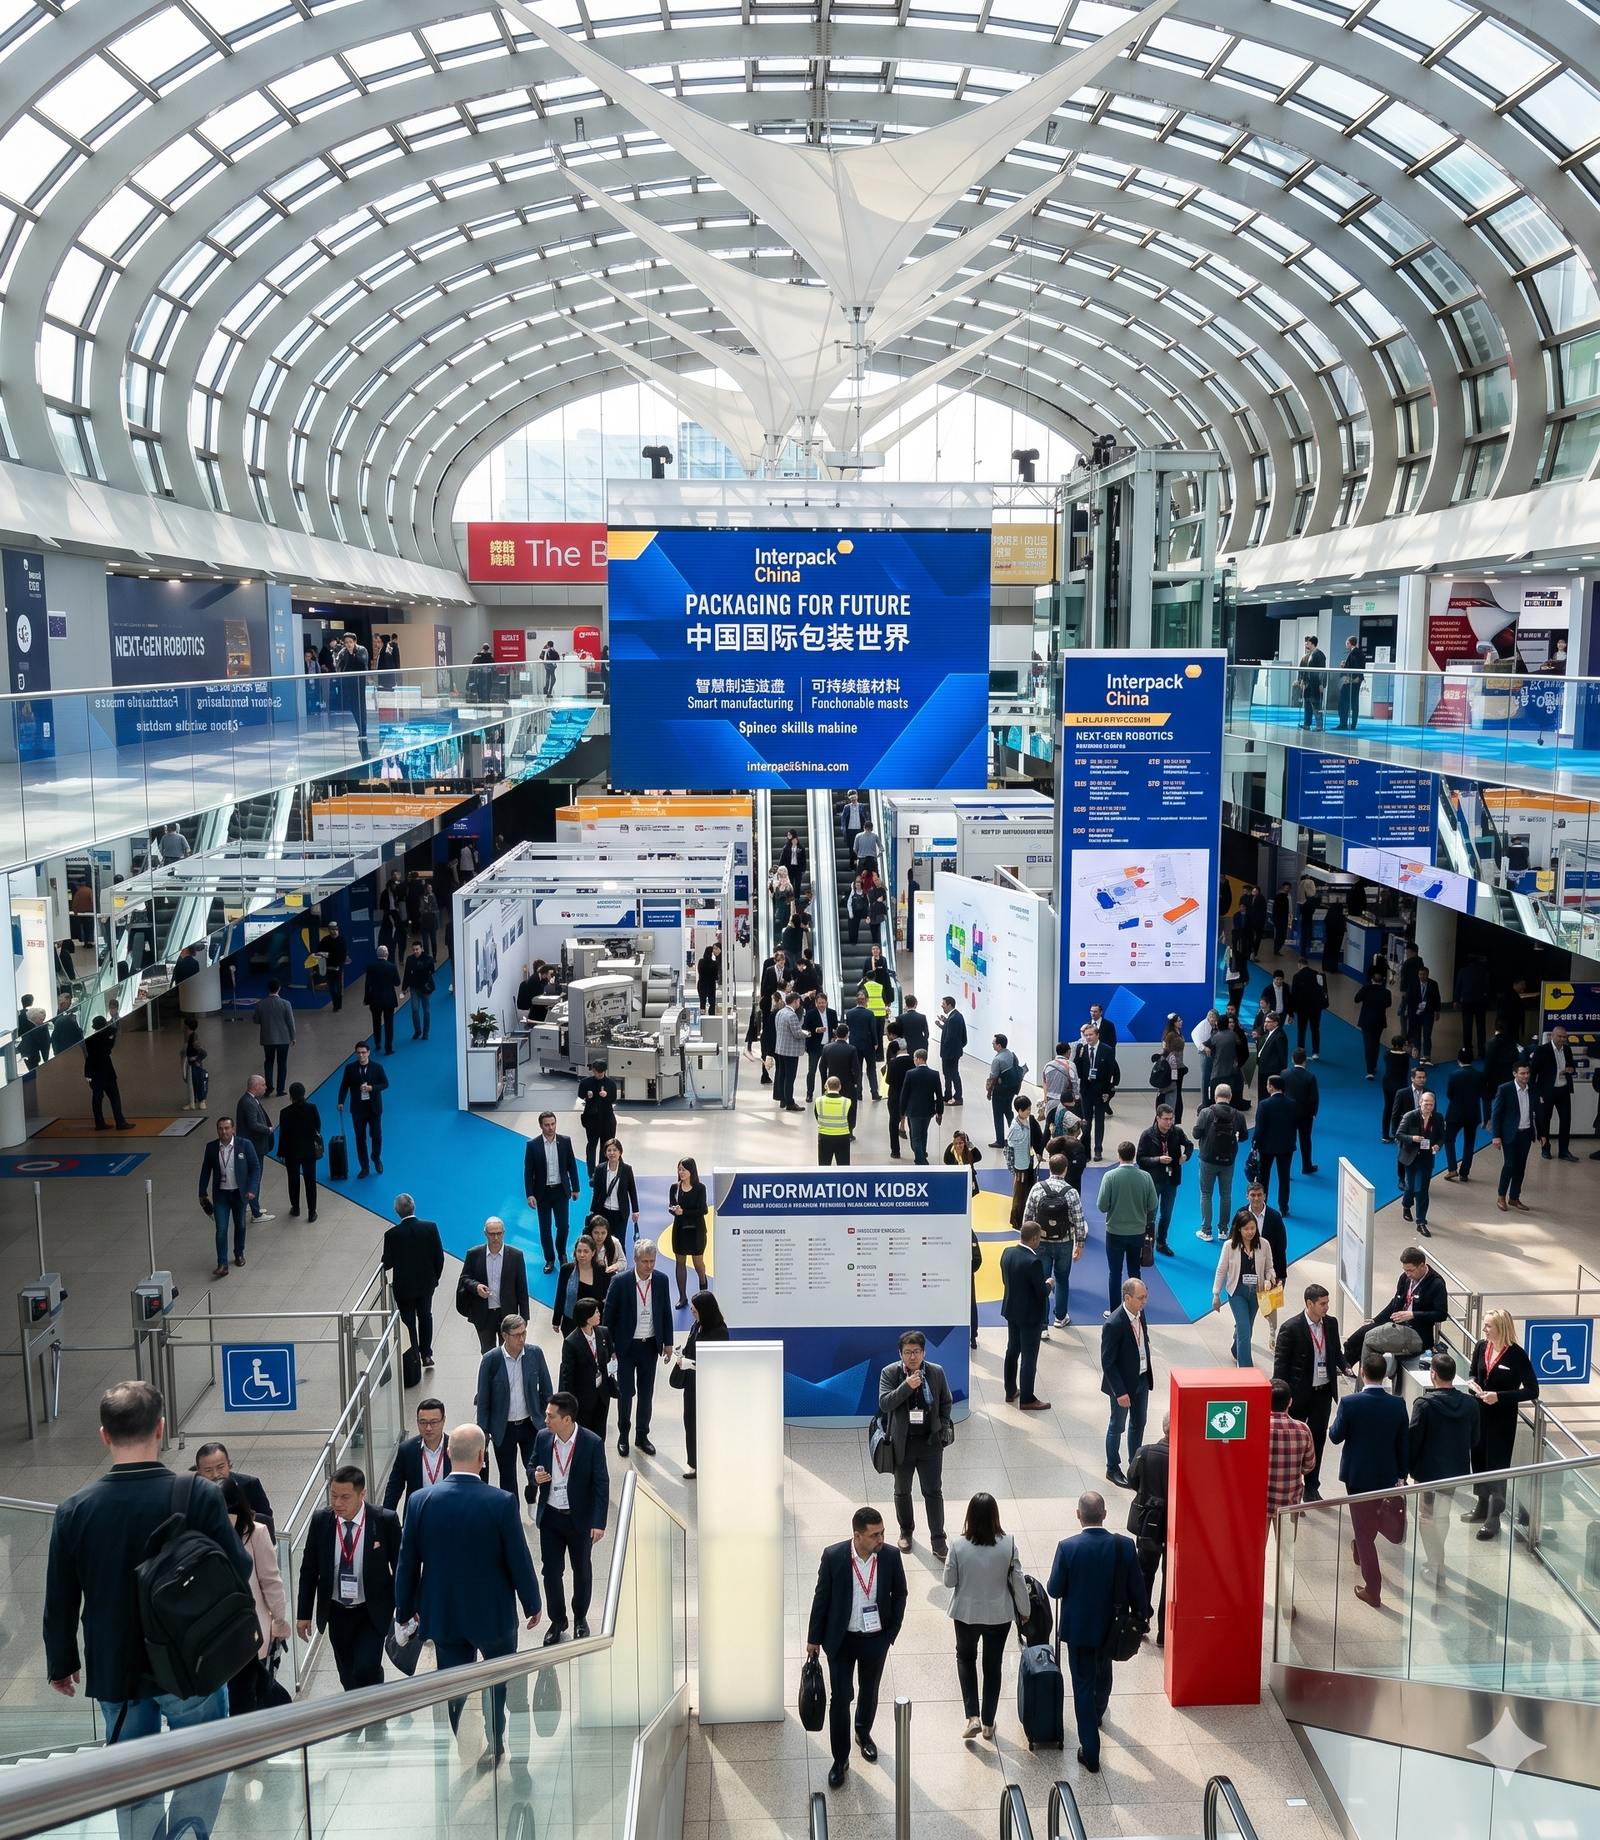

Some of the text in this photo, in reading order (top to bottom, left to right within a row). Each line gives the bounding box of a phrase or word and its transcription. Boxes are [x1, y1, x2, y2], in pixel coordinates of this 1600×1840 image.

[525, 539, 581, 567] The
[755, 548, 838, 568] Interpack
[754, 567, 801, 583] China
[685, 594, 911, 616] PACKAGING FOR FUTURE
[115, 635, 205, 657] NEXT-GEN ROBOTICS
[686, 623, 911, 652] 中国国际包装世界
[1107, 673, 1184, 693] Interpack
[687, 696, 794, 712] Smart manufacturing
[877, 697, 909, 709] masts
[1106, 691, 1150, 706] China
[1076, 731, 1174, 741] NEXT-GEN ROBOTICS
[742, 1182, 868, 1199] INFORMATION
